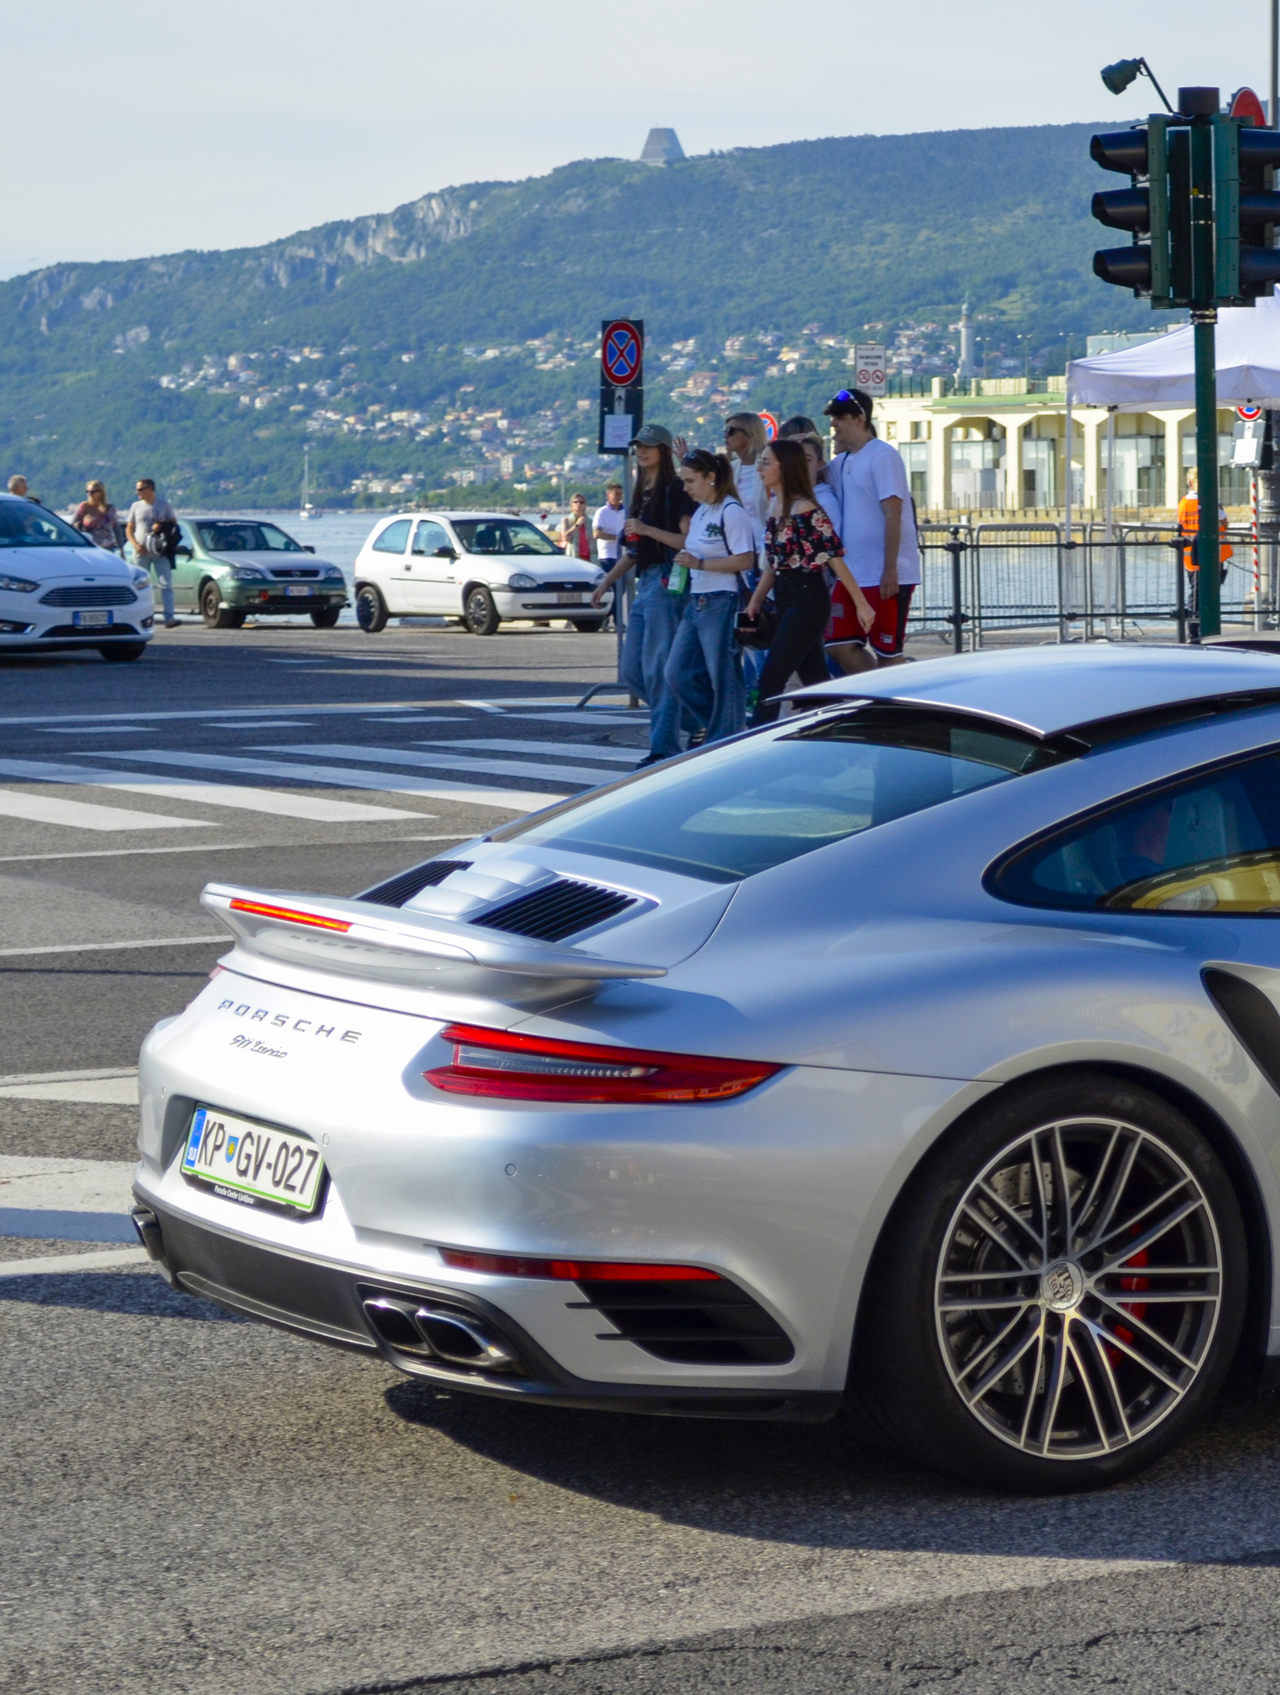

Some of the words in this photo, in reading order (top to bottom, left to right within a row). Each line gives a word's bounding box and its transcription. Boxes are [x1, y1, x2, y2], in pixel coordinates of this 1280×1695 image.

[217, 999, 362, 1044] PORSCHE
[198, 1119, 226, 1167] KP
[236, 1131, 319, 1195] GV-027
